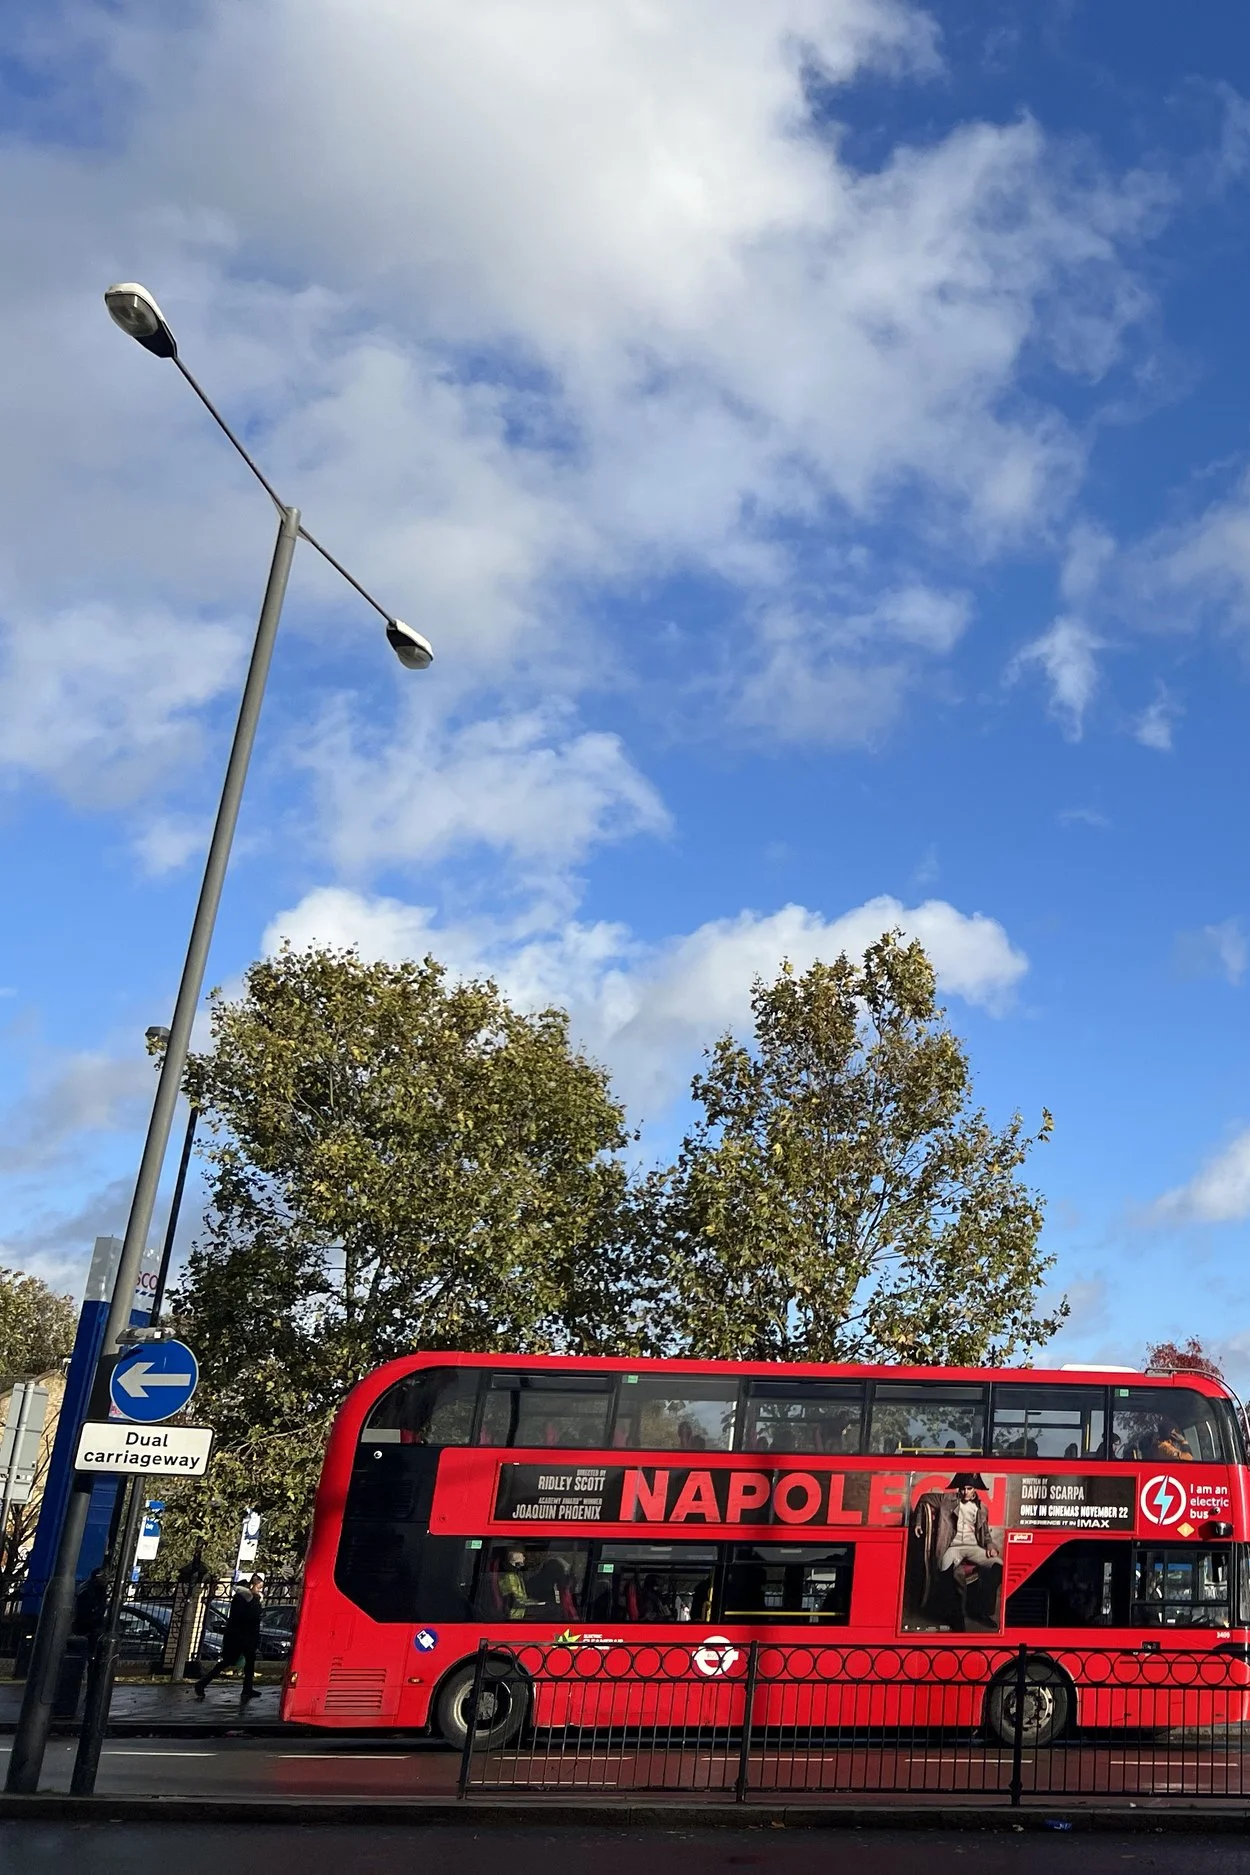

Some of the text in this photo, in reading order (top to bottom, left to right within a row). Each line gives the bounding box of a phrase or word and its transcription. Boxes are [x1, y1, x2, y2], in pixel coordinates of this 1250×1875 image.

[126, 1432, 168, 1447] Dual
[84, 1450, 200, 1470] carriageway
[538, 1476, 605, 1491] RIDLEY SCOTT
[1197, 1486, 1212, 1494] am
[1215, 1486, 1227, 1494] an
[1021, 1485, 1084, 1500] DAVID SCARPA
[1190, 1498, 1229, 1507] electric
[512, 1504, 601, 1520] JOAQUIN PHOENIX
[1020, 1504, 1128, 1518] ONLY IN CINEMAS NOVEMBER 22
[1190, 1509, 1209, 1519] bus
[1077, 1519, 1110, 1528] IMAX
